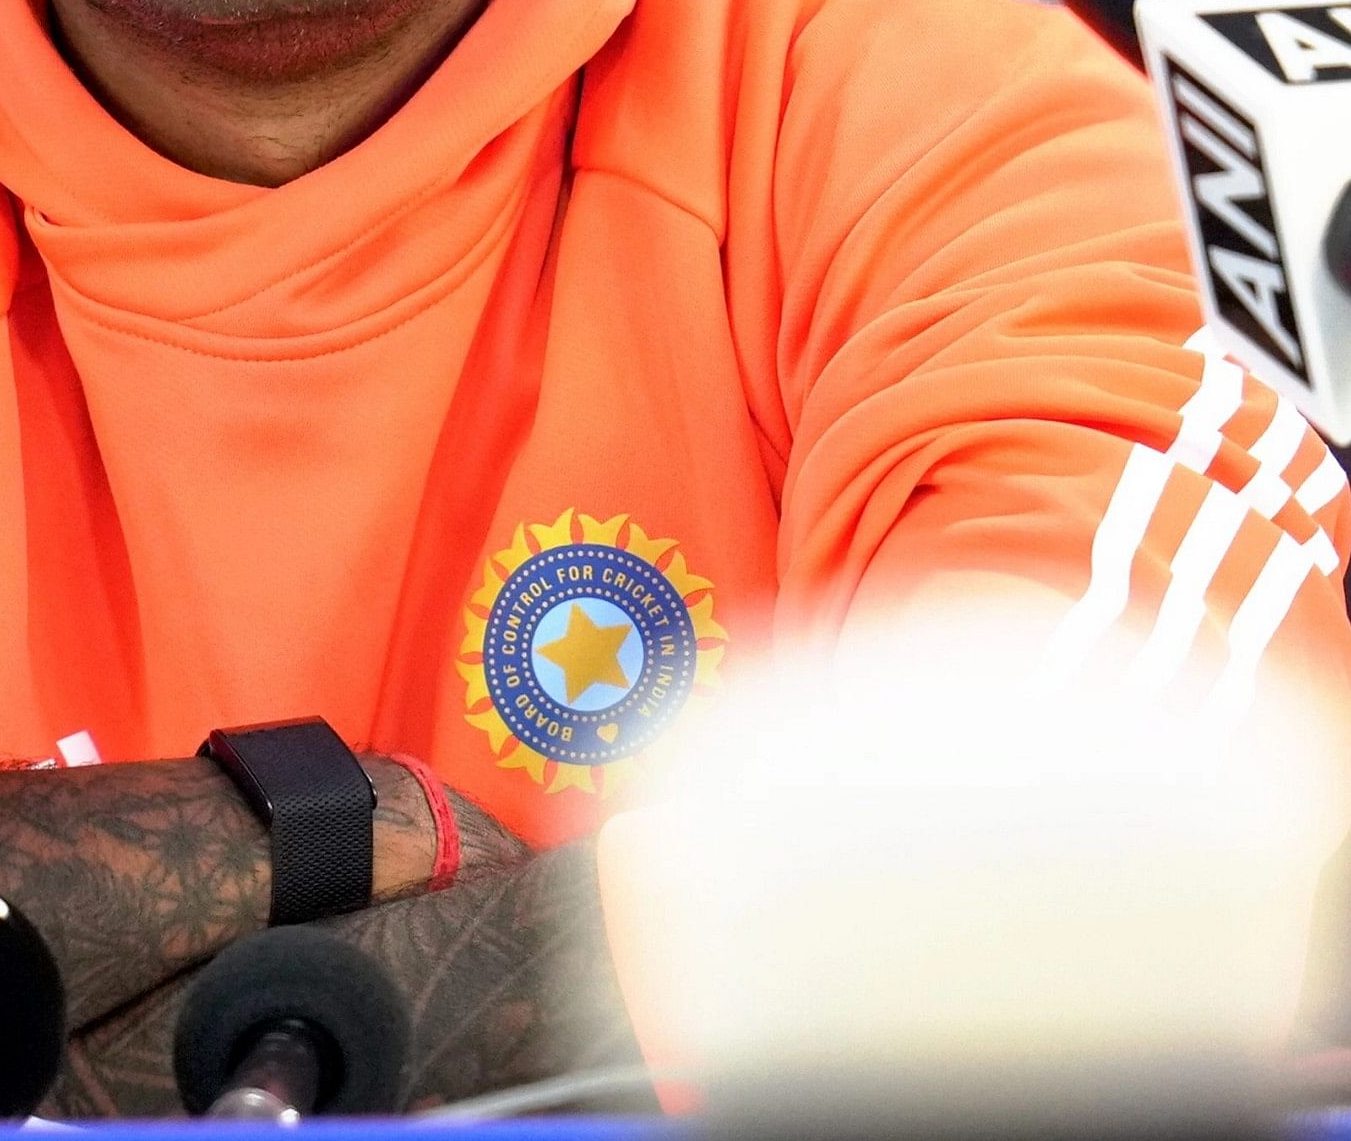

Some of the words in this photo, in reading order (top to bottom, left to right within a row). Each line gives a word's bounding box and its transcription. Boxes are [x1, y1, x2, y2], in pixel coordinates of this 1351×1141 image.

[1171, 73, 1301, 366] ANI
[556, 565, 593, 583] FOR
[602, 568, 670, 627] CRICKET
[502, 577, 553, 655] CONTROL
[659, 635, 675, 656] IN
[503, 664, 520, 688] OF
[638, 664, 675, 718] INDIA
[515, 694, 573, 742] BOARD
